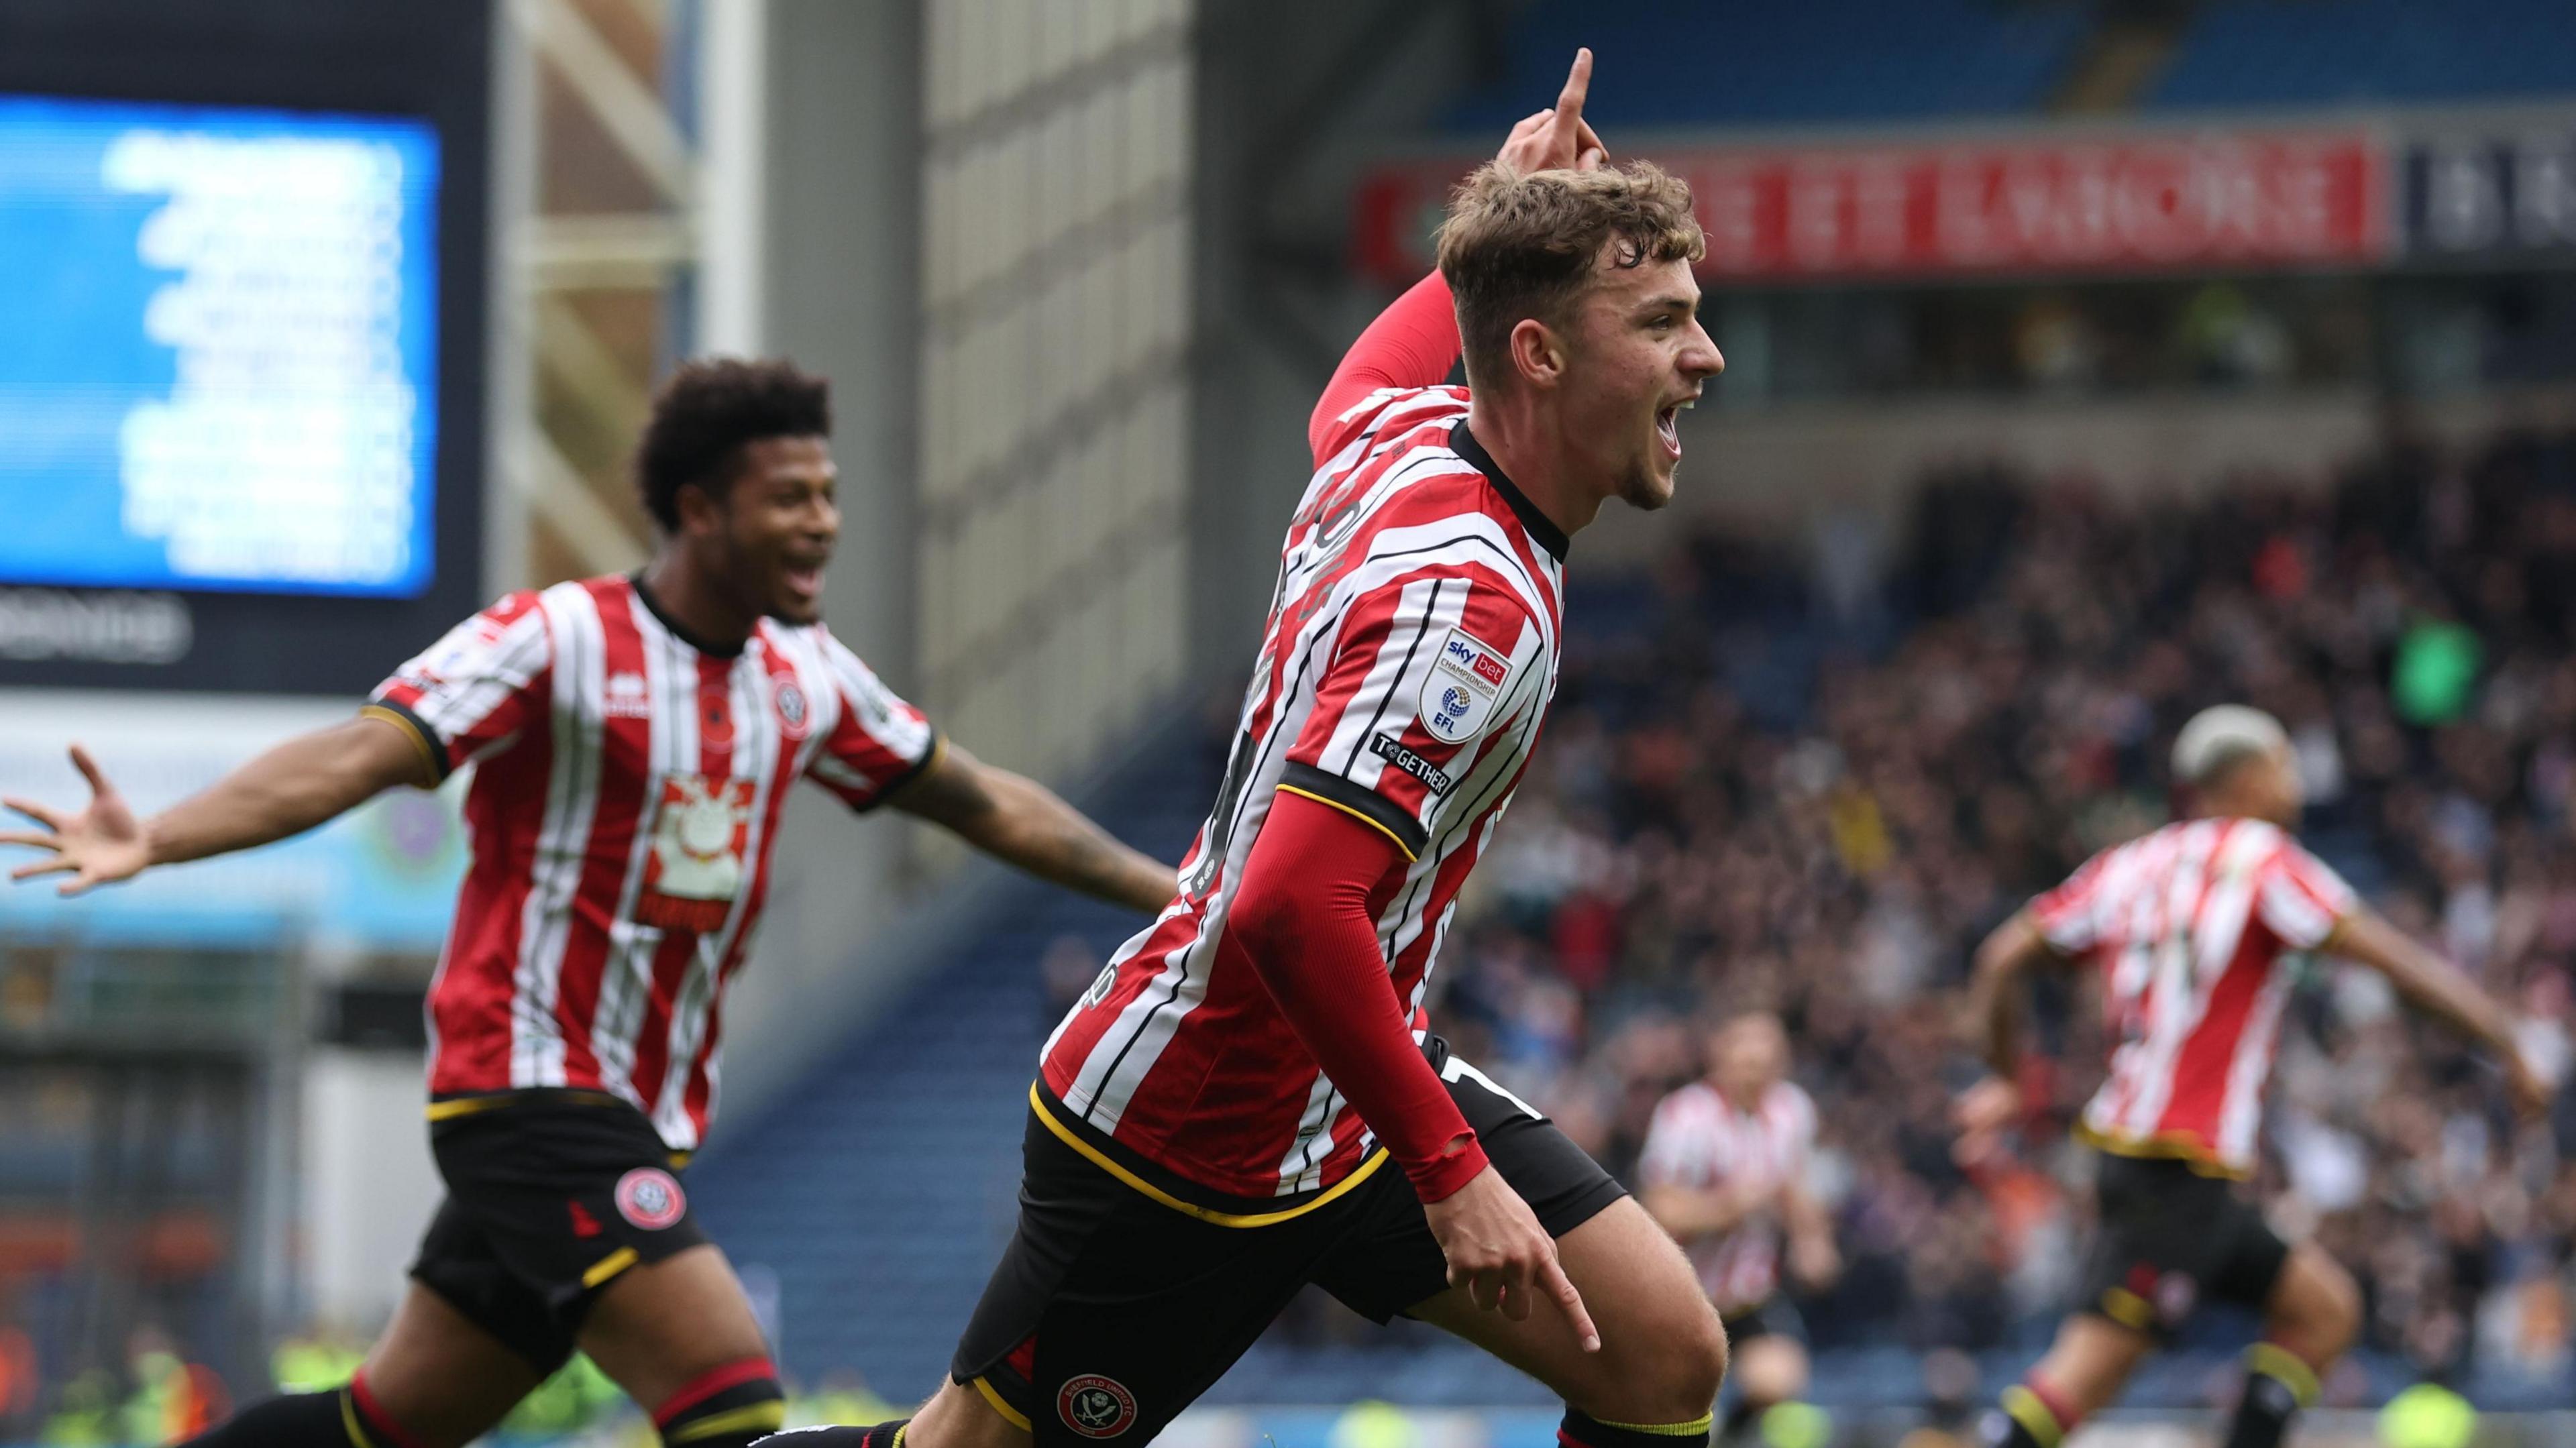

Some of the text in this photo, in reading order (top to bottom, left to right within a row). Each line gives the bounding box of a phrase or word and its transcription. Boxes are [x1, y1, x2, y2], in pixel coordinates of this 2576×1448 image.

[1440, 657, 1496, 695] CHAMPIONSHIP
[1448, 641, 1502, 681] sky bet
[1434, 712, 1454, 734] EFL
